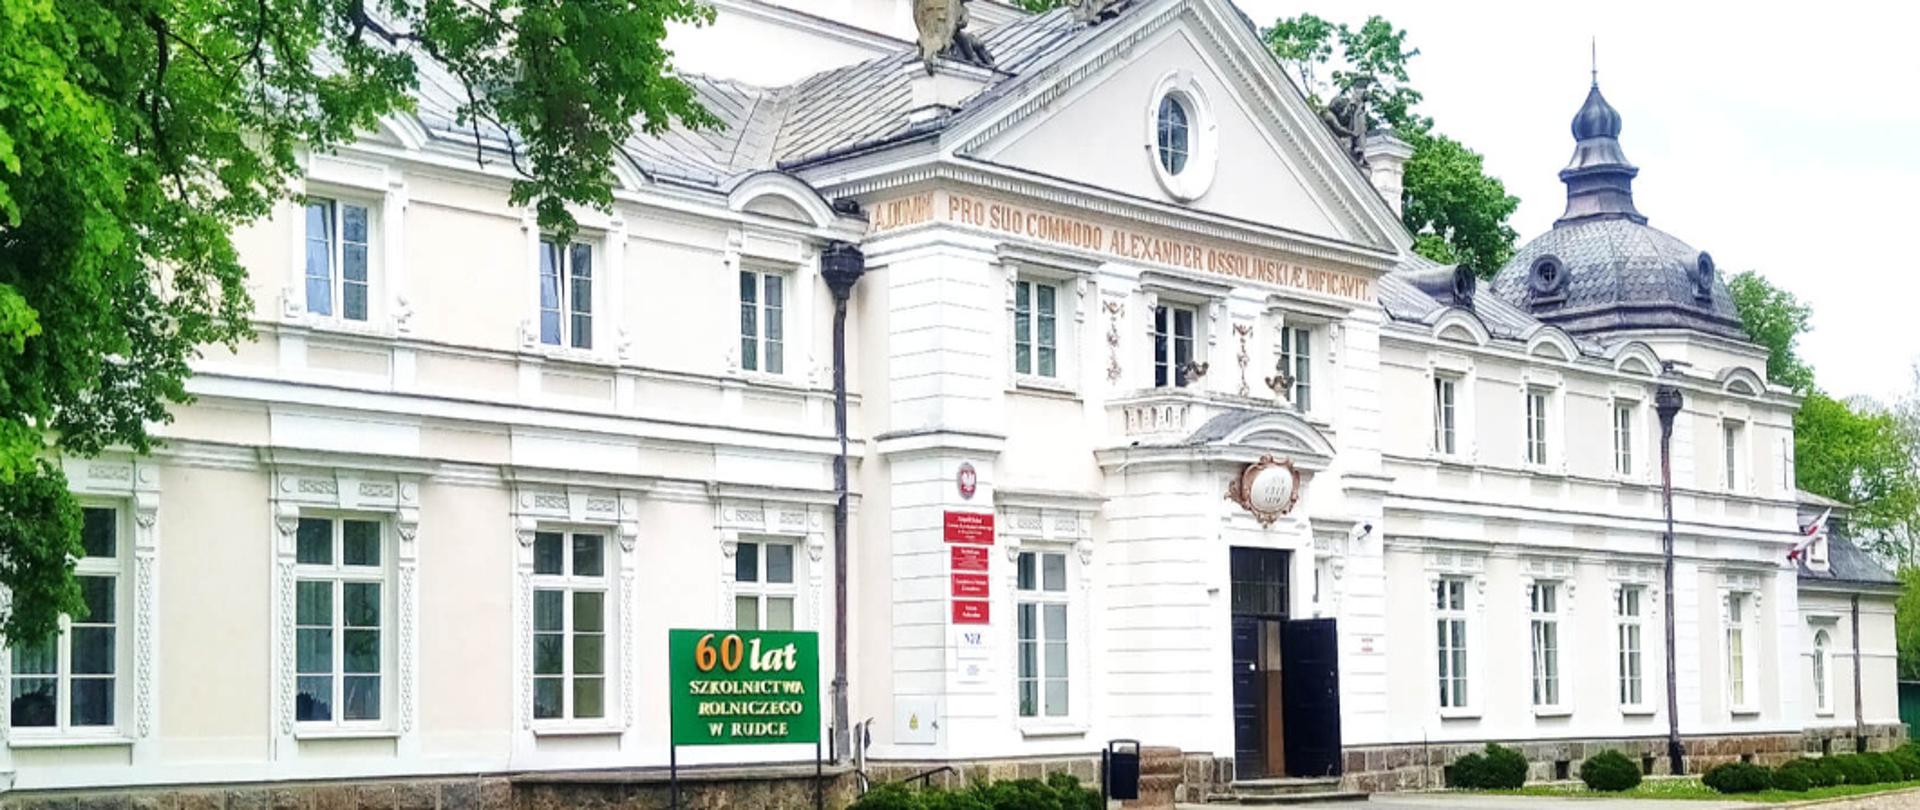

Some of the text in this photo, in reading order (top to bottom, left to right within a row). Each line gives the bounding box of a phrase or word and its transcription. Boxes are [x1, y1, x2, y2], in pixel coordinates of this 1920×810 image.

[948, 195, 985, 226] PRO
[991, 203, 1022, 234] SUO
[1026, 213, 1102, 251] COMMODO
[1109, 229, 1203, 271] ALEXANDER
[695, 634, 797, 671] 60 lat
[689, 680, 804, 695] SZKOLNICTWA
[698, 701, 803, 716] ROLNICZEGO
[708, 722, 788, 737] W RUDCE
